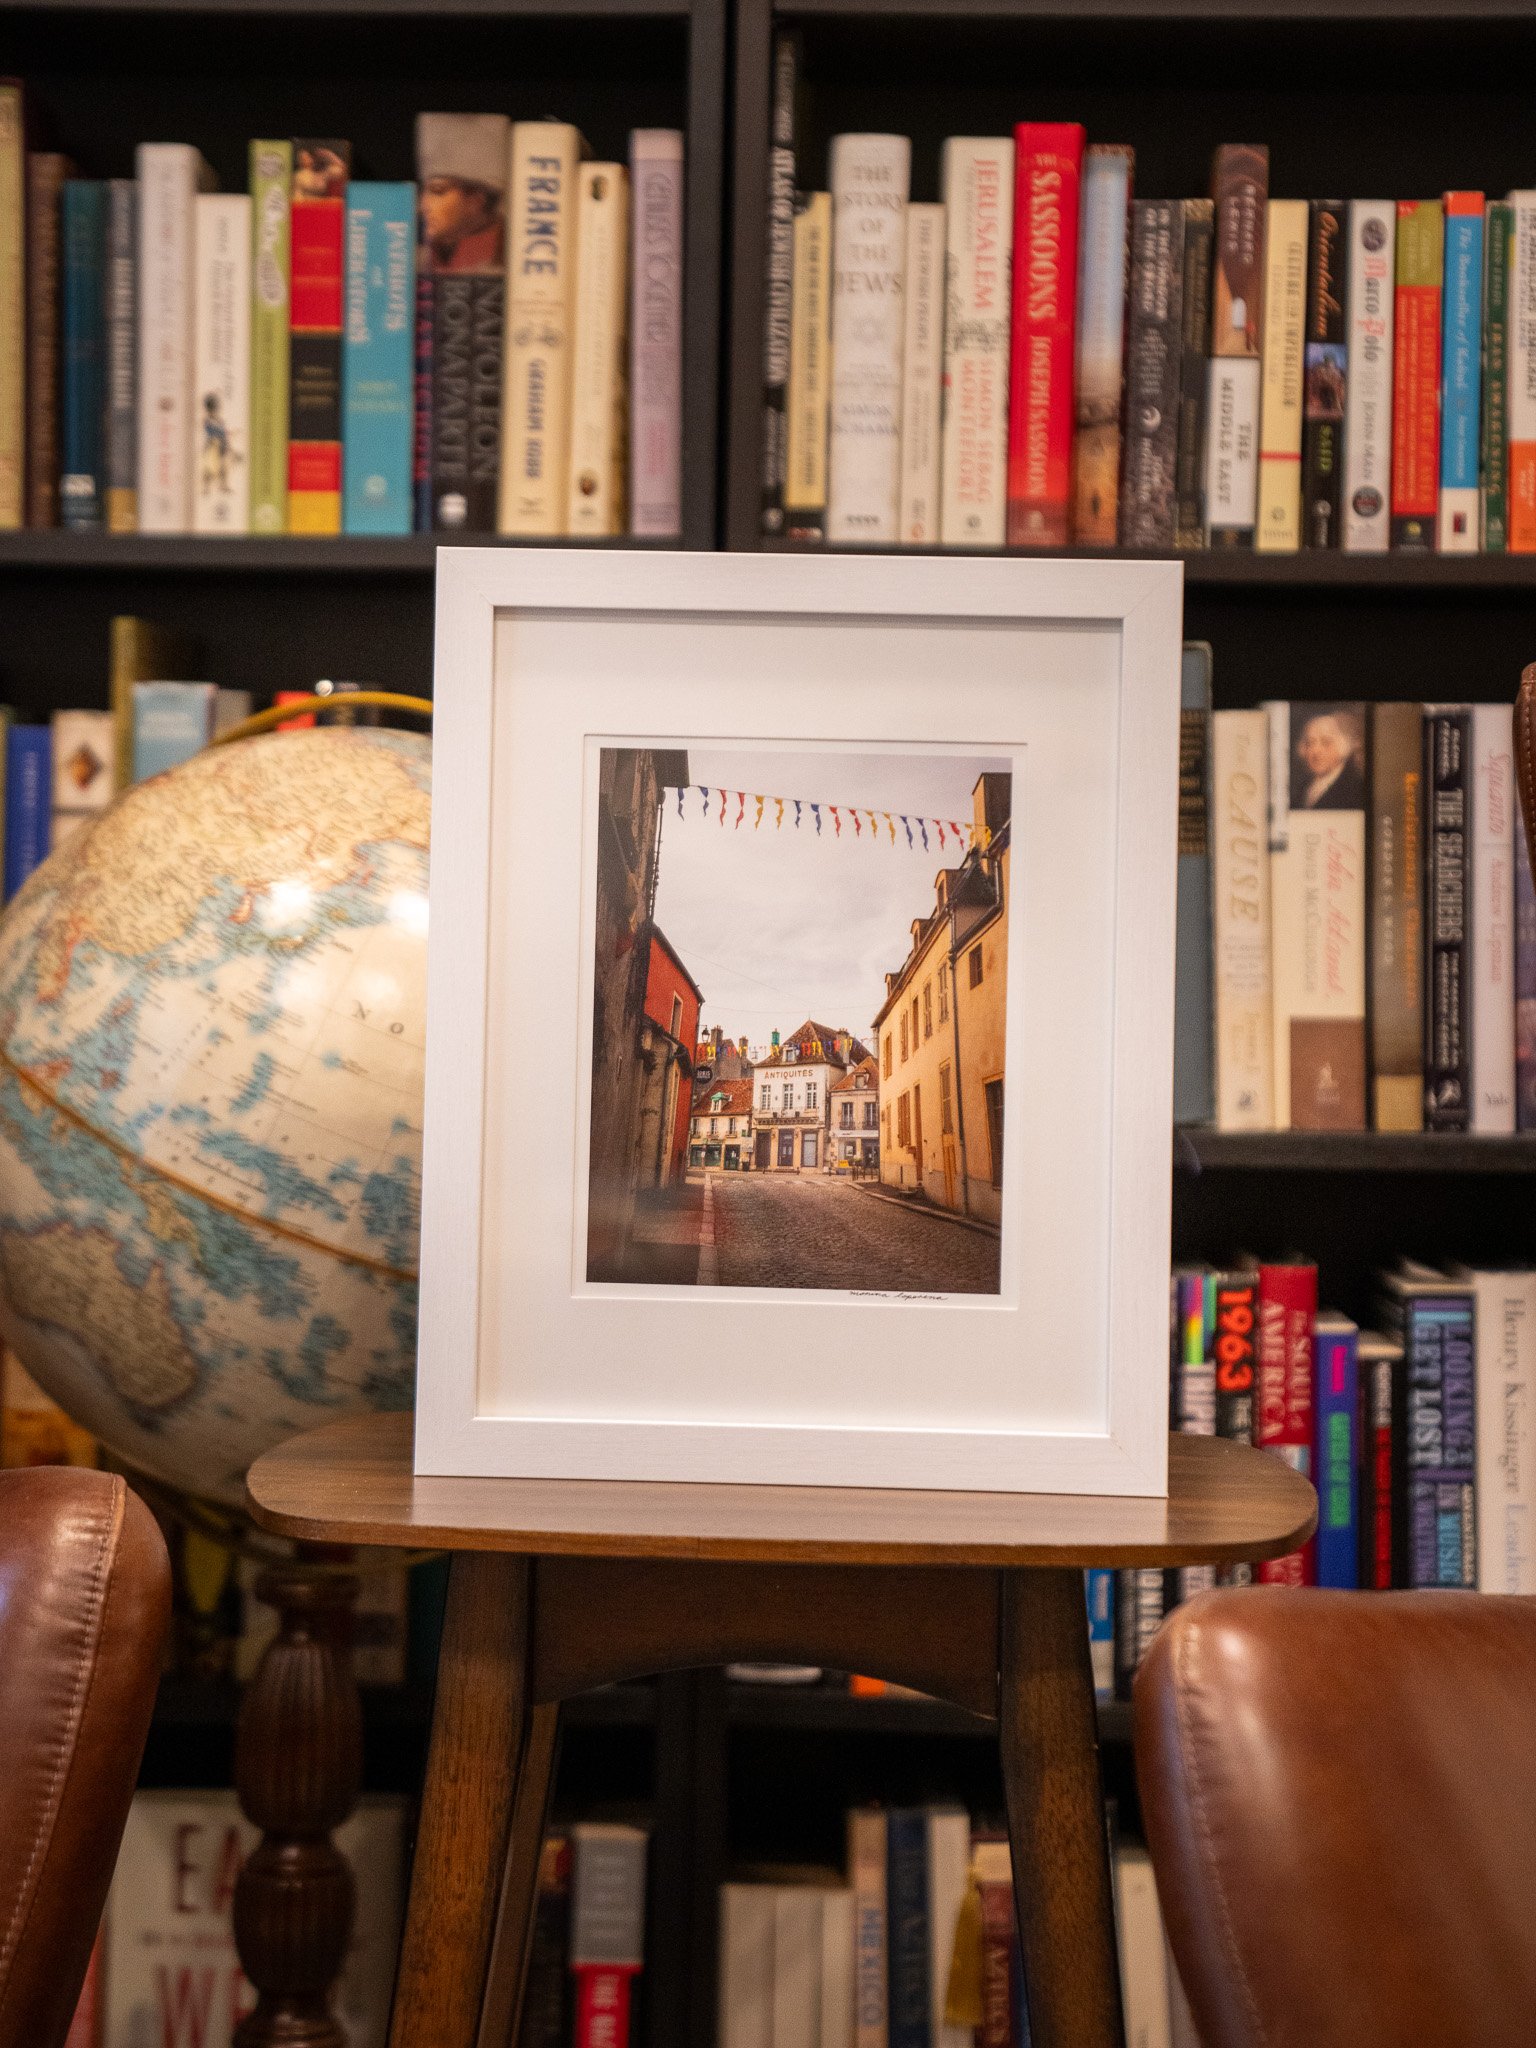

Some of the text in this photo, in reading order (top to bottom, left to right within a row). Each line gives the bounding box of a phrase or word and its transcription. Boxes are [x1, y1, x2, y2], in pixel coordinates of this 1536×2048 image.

[523, 156, 562, 278] FRANCE
[973, 159, 1000, 310] JERUSALEM
[1028, 170, 1062, 321] SASSOONS
[1356, 256, 1388, 363] Marco Polo
[438, 279, 470, 479] BONAPARTE
[470, 279, 501, 482] NAPOLEON
[526, 359, 548, 432] GRAHAM
[1217, 377, 1235, 505] MIDDLE EAST
[1237, 422, 1253, 461] THE
[1229, 771, 1260, 926] CAUSE
[1480, 750, 1512, 836] Squanto
[1326, 828, 1358, 892] John
[1436, 788, 1464, 943] THE SEARCHERS
[1218, 1288, 1254, 1391] 1963
[1262, 1298, 1287, 1441] AMERICA
[1288, 1335, 1312, 1412] SOUL
[1413, 1322, 1444, 1467] GET LOST
[1443, 1322, 1474, 1446] LOOKING
[1496, 1297, 1527, 1372] Henry
[1496, 1382, 1527, 1494] Kissinger
[1437, 1512, 1462, 1583] MUSIC
